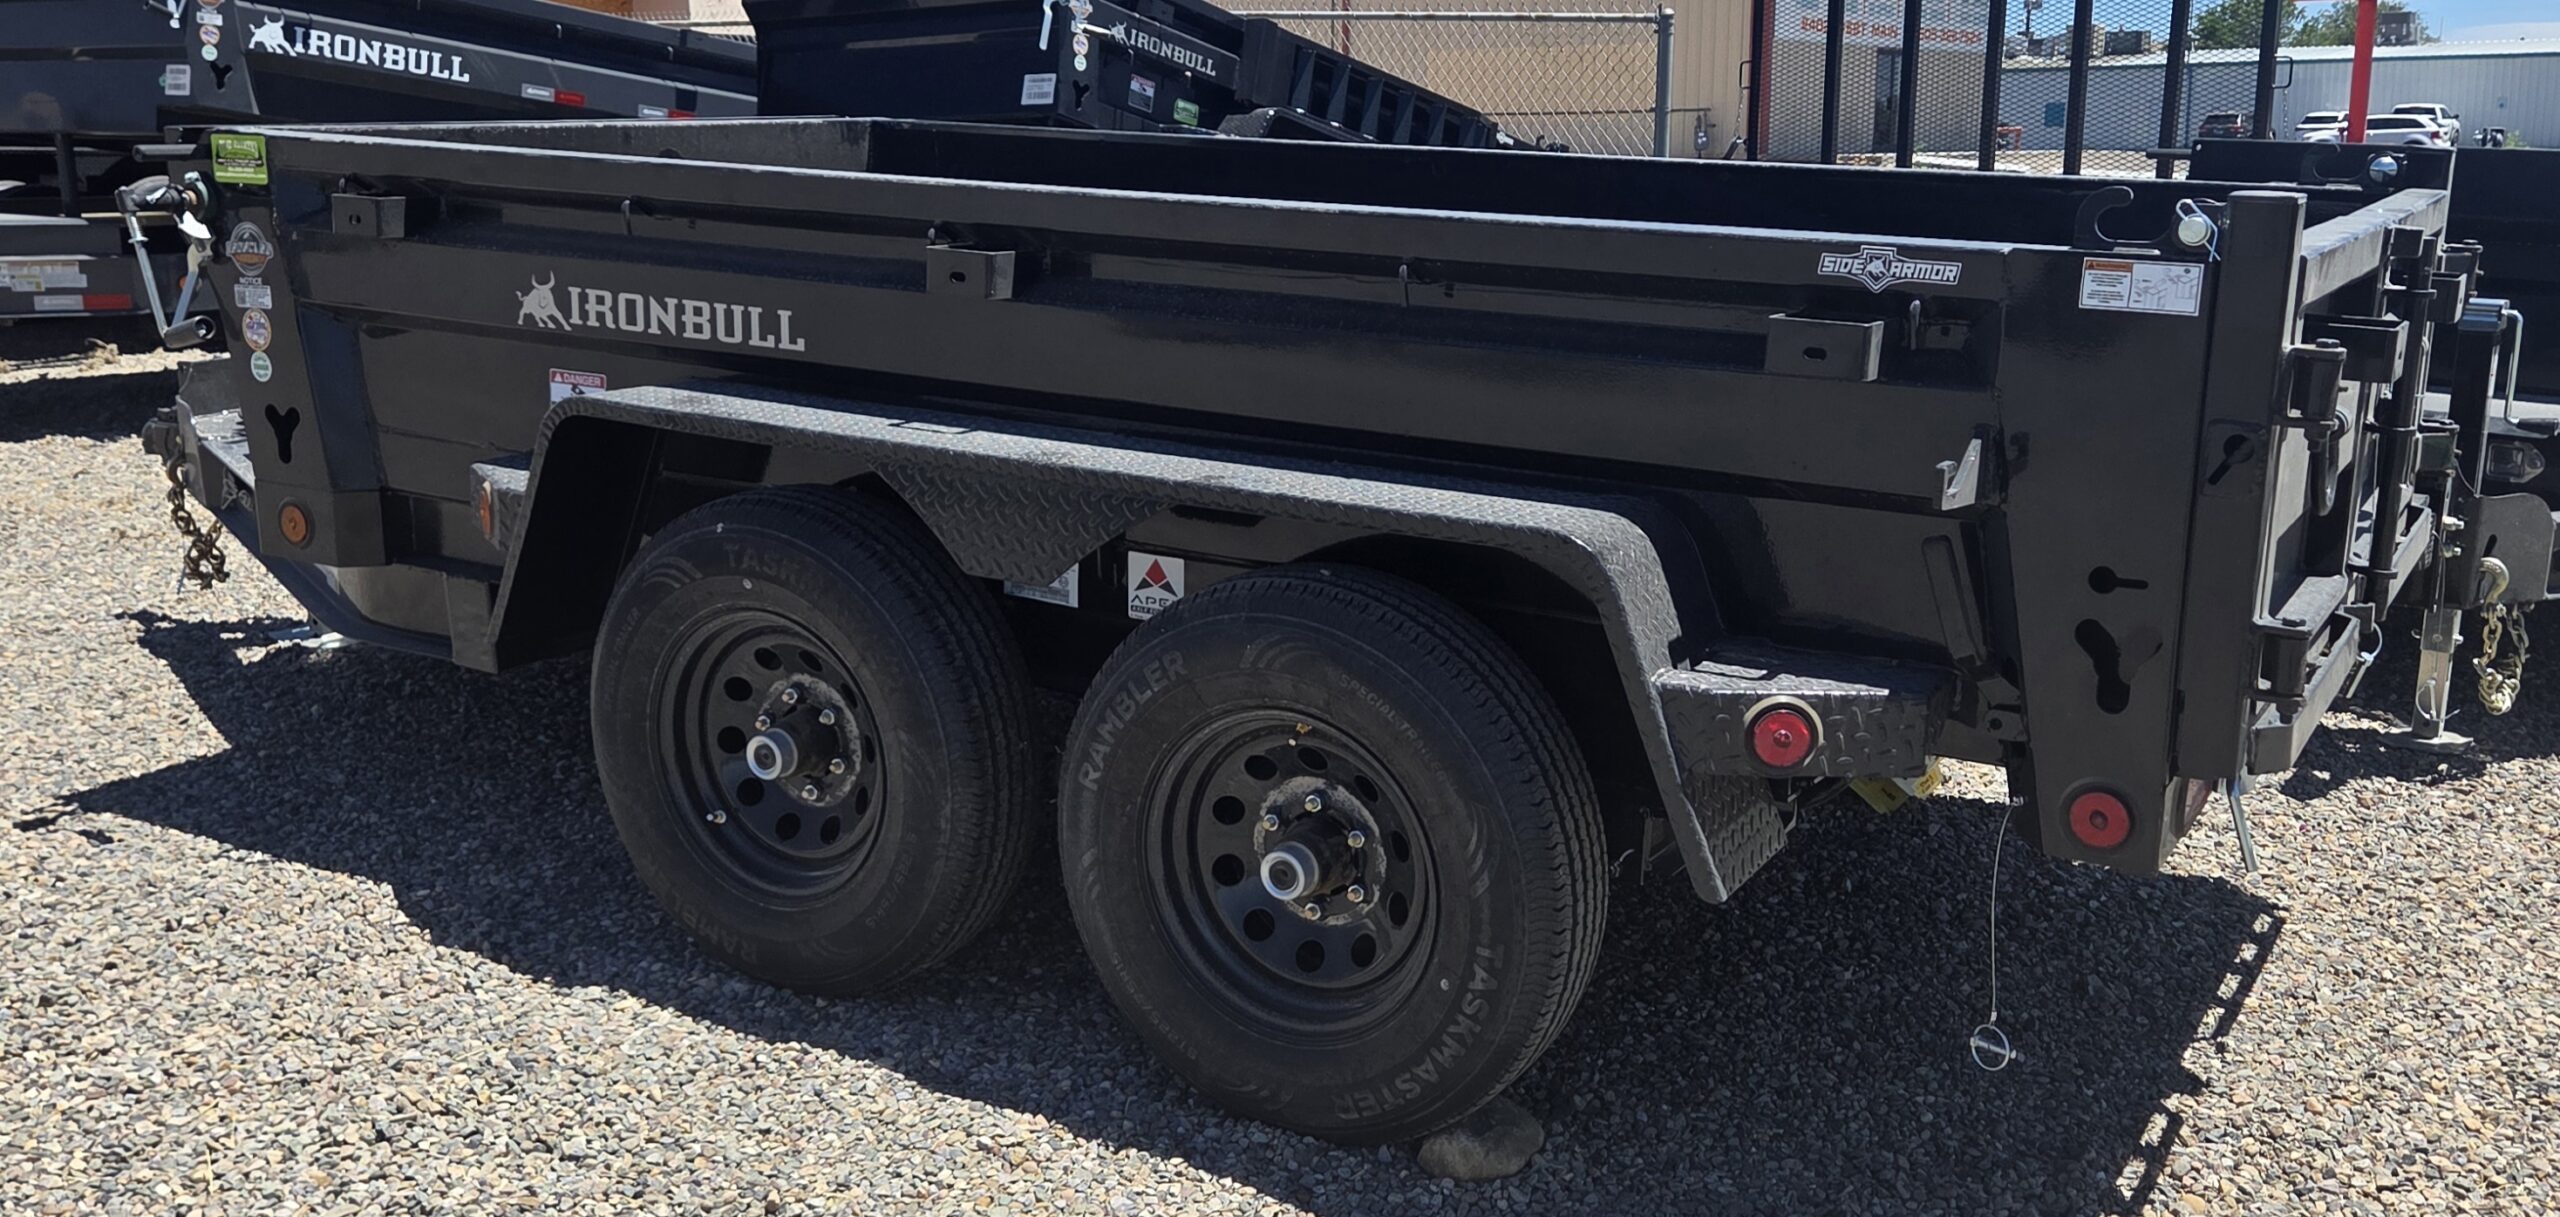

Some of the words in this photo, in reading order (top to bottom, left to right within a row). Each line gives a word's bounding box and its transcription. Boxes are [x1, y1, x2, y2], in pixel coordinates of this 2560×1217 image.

[294, 26, 470, 83] IRONBULL
[1130, 28, 1216, 77] IRONBULL
[1822, 256, 1865, 275] SIDE
[1889, 261, 1958, 281] ARMOR
[568, 286, 805, 352] IRONBULL
[563, 373, 601, 387] DANGER
[1131, 594, 1174, 608] APE
[1078, 650, 1188, 792] RAMBLER
[1338, 673, 1398, 723] SPECIAL
[1330, 943, 1505, 1121] TASKMASTER
